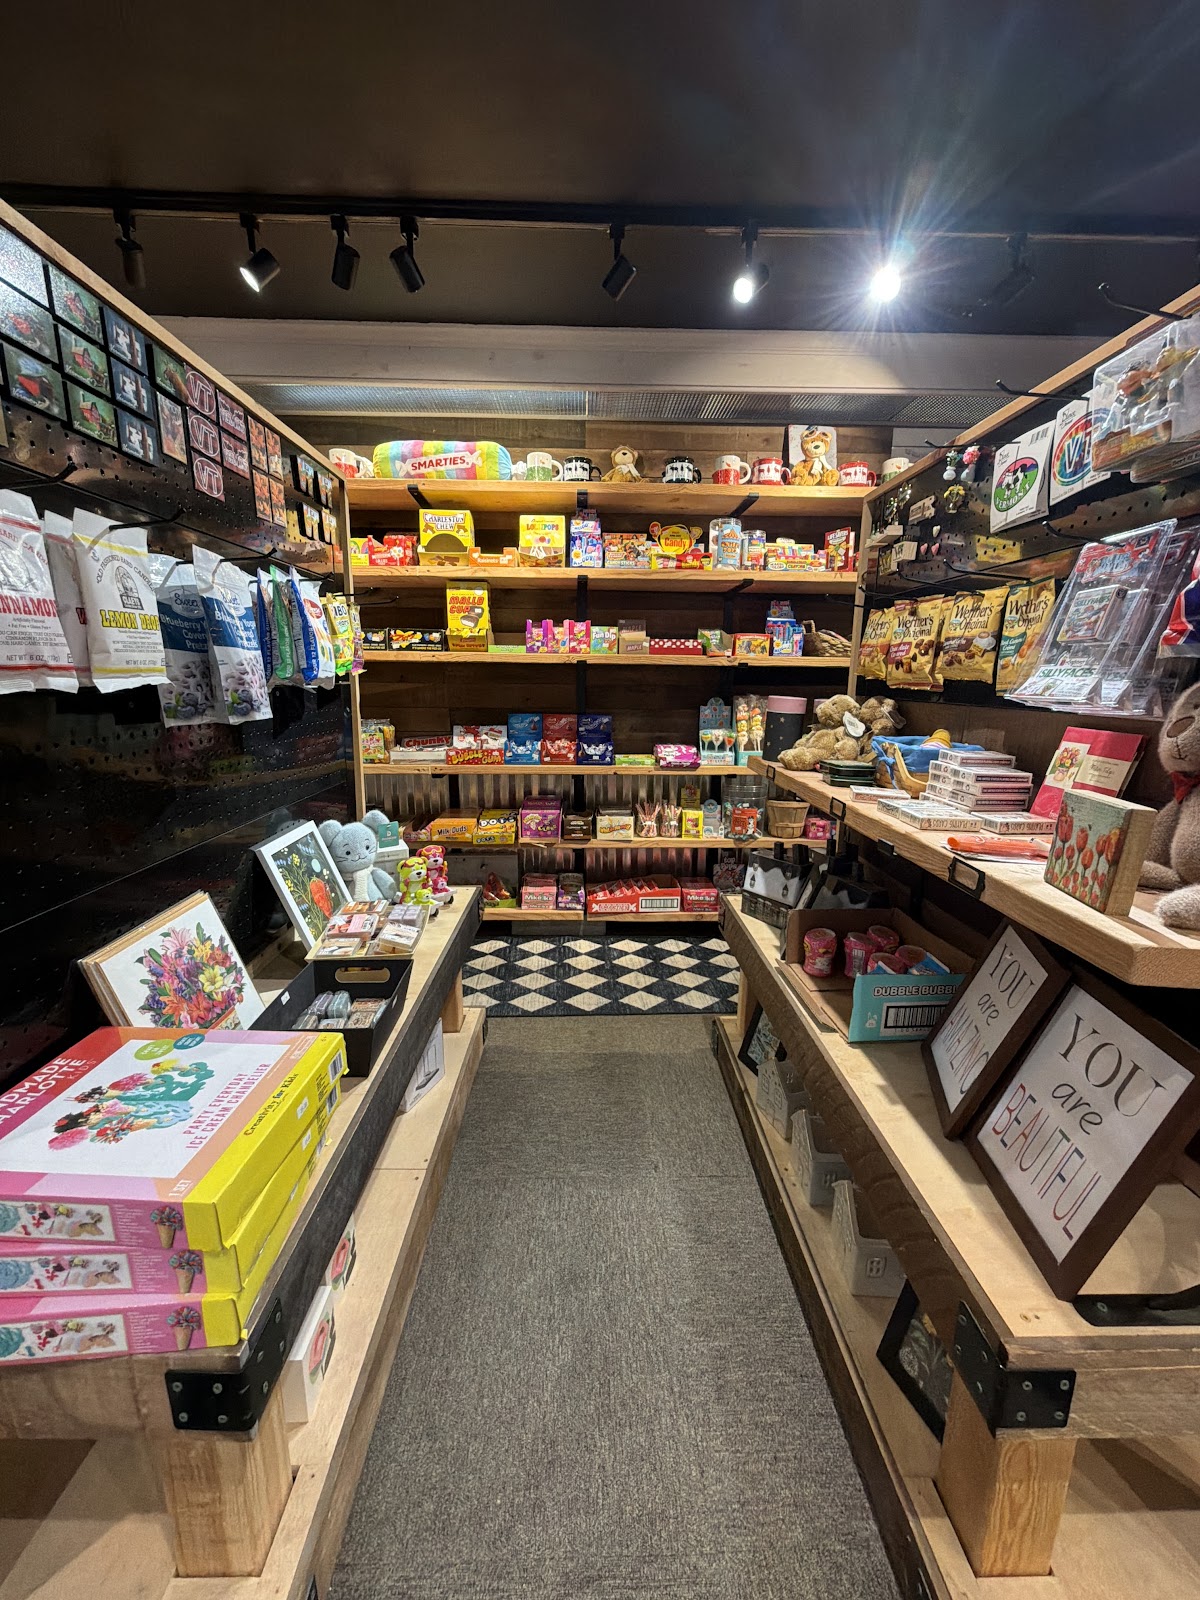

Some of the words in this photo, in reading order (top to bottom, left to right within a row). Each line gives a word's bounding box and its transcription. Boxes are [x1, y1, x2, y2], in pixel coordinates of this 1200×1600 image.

[190, 374, 212, 412] VT
[193, 419, 215, 454] VT
[411, 456, 467, 471] SMARTIES
[197, 461, 219, 495] VT
[664, 538, 687, 550] Candy
[0, 593, 57, 617] NNAMON
[448, 596, 485, 606] MALLO
[448, 606, 471, 614] CUP
[100, 609, 138, 629] LEMON
[160, 613, 201, 629] Blueberry
[182, 629, 208, 640] Cover
[592, 632, 604, 640] Fun
[604, 631, 617, 641] Dip
[185, 639, 208, 650] Pretz
[6, 654, 17, 662] NET
[1040, 667, 1097, 678] SILLYFACES
[405, 735, 452, 748] Chunky
[451, 749, 483, 765] BUBBLE
[481, 754, 502, 765] GUM
[480, 815, 515, 828] DOTS
[437, 828, 450, 836] Milk
[451, 825, 468, 834] Duds
[989, 942, 1036, 1009] YOU
[873, 985, 919, 997] DUBBLE
[920, 984, 957, 996] BUBBL
[977, 991, 1000, 1027] are
[67, 1058, 97, 1079] KIDS
[1058, 1012, 1168, 1118] YOU
[183, 1109, 210, 1135] PARTY
[208, 1072, 249, 1108] EVERYDAY
[186, 1135, 208, 1150] ICE
[202, 1103, 232, 1133] CREAM
[227, 1063, 272, 1106] CHANDELIER
[243, 1099, 277, 1137] Creativity
[275, 1088, 285, 1100] for
[281, 1072, 300, 1091] Kids
[1051, 1081, 1103, 1136] are
[991, 1082, 1102, 1241] BEAUTIFUL
[179, 1179, 192, 1194] SET
